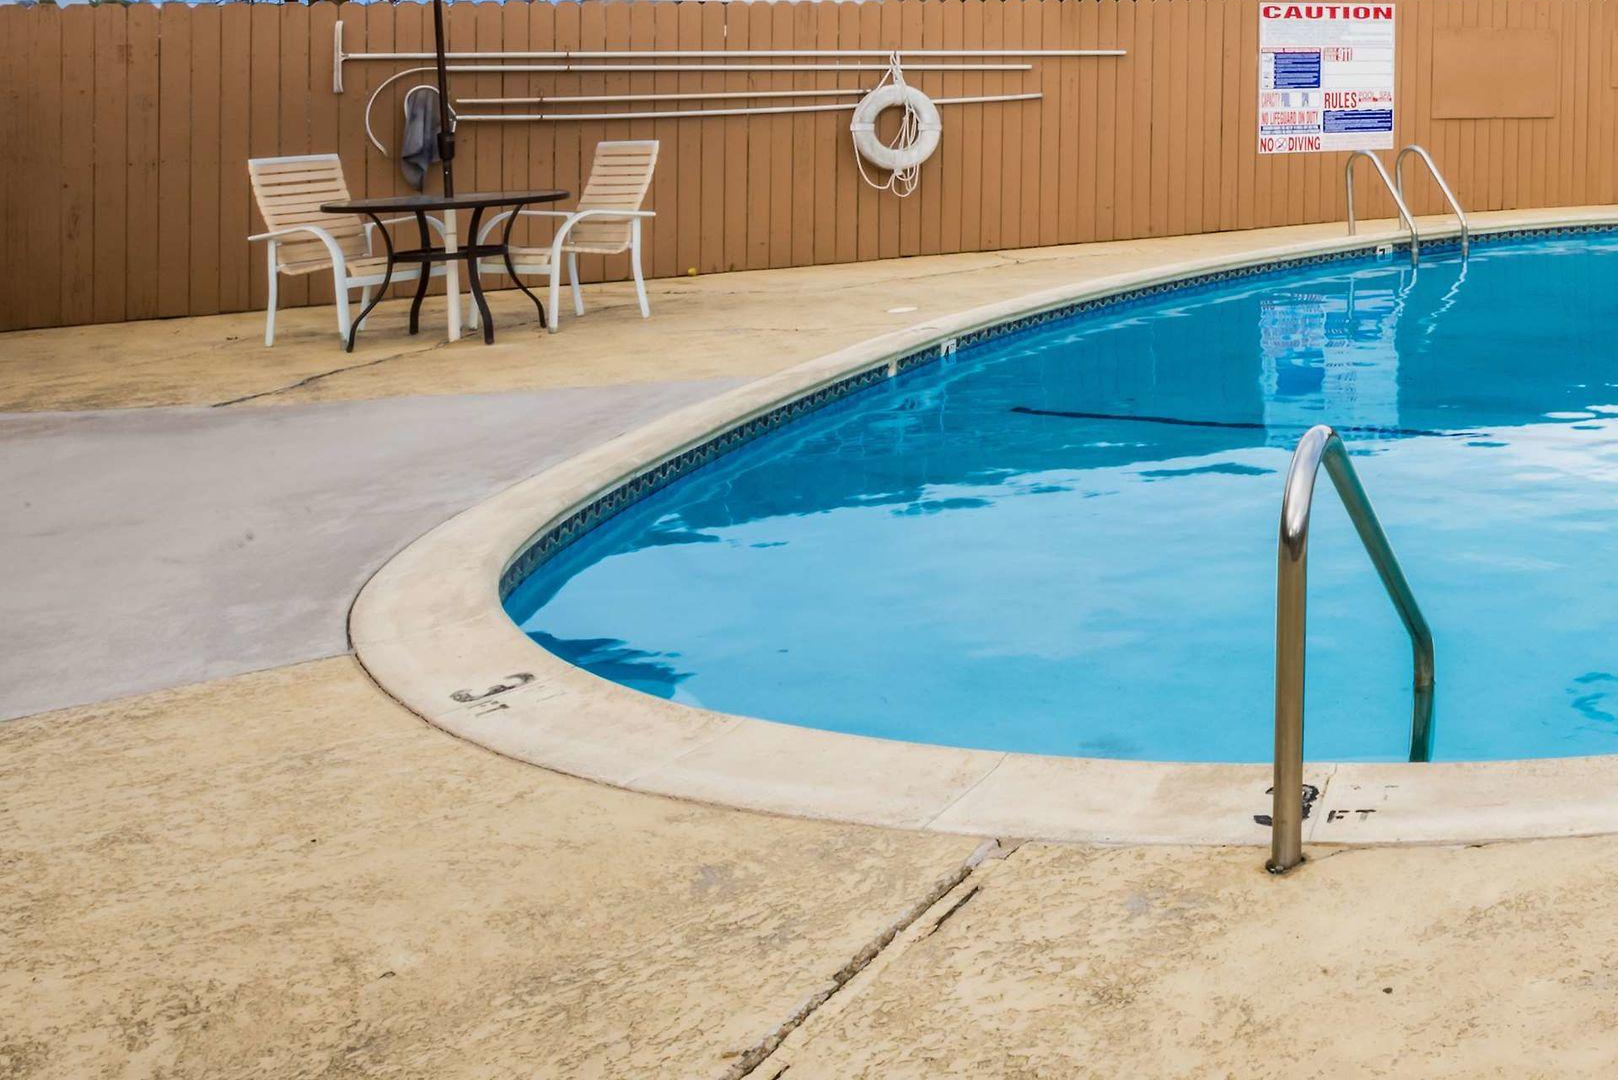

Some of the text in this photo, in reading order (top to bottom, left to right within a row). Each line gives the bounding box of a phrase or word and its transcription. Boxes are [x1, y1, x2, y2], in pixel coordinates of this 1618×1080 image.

[1263, 6, 1392, 20] CAUTION
[1324, 92, 1357, 109] RULES
[1260, 136, 1321, 152] NO DIVING
